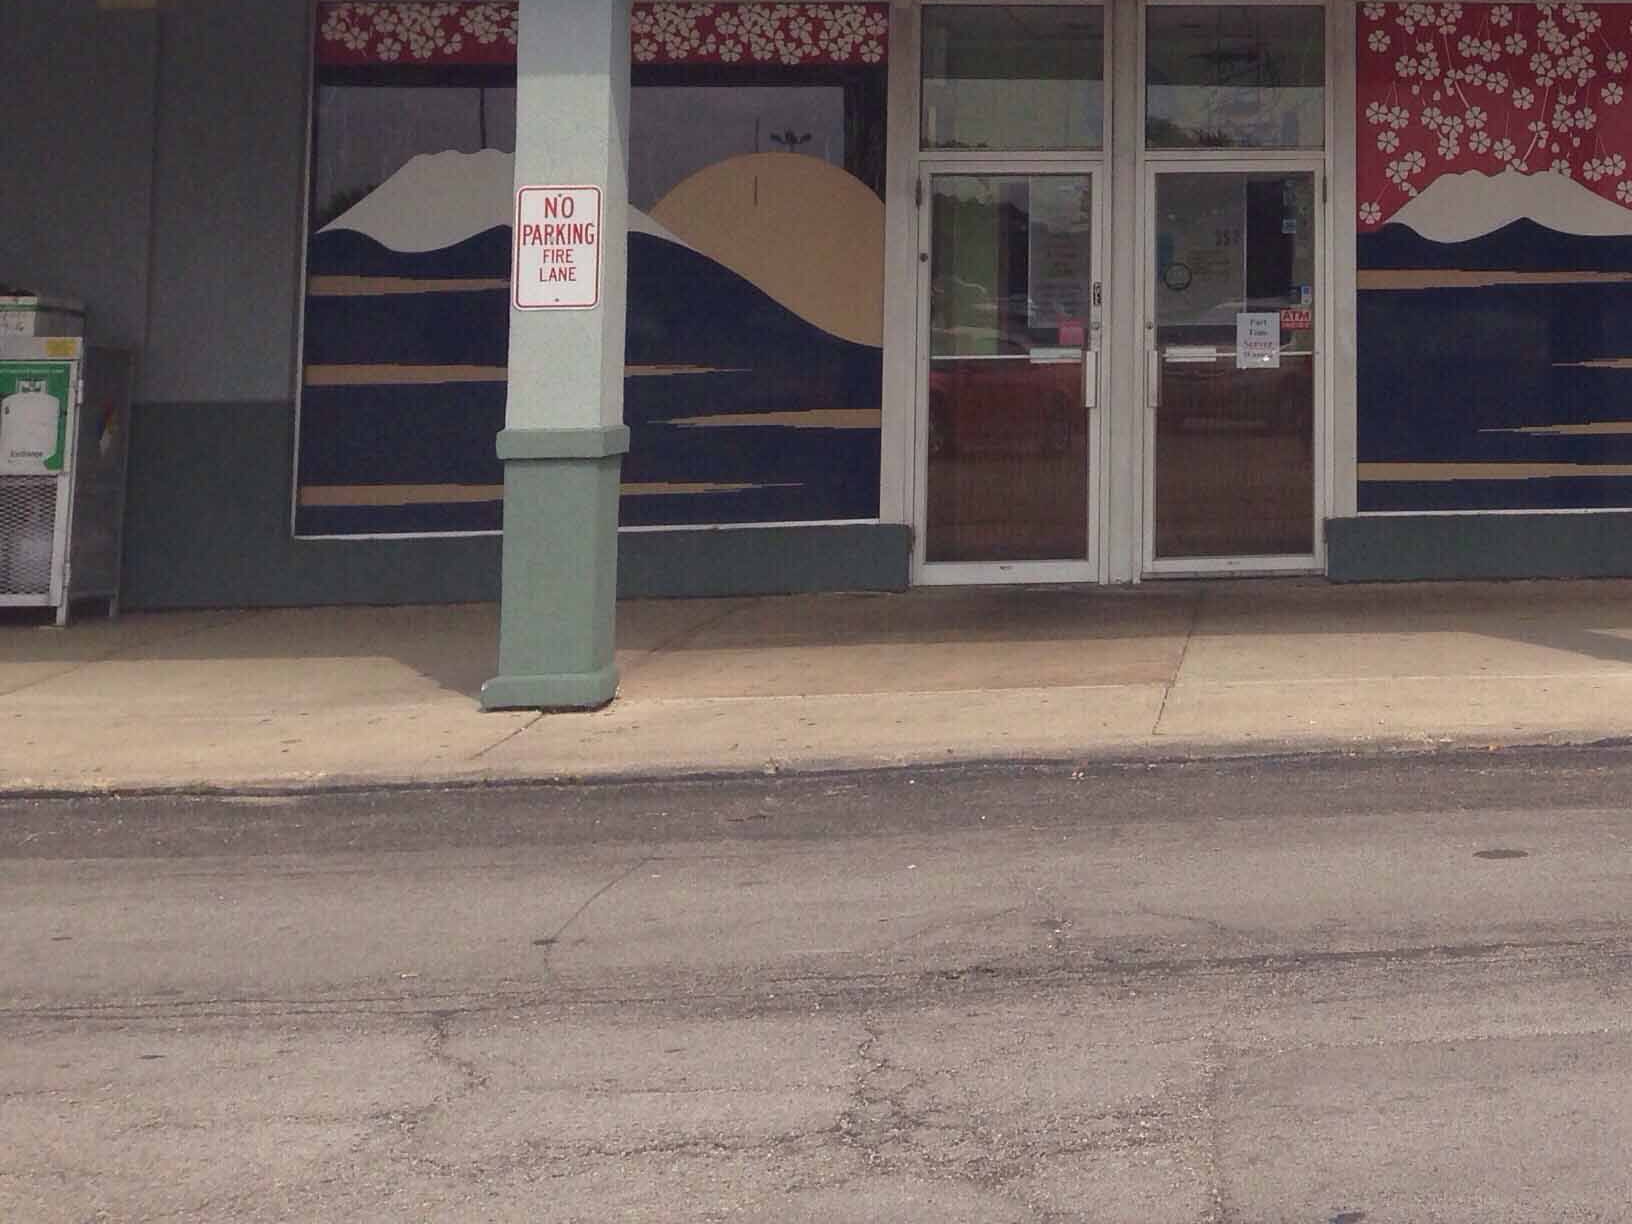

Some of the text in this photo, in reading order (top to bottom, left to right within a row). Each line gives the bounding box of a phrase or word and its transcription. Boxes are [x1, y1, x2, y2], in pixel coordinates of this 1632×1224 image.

[544, 196, 574, 218] NO
[522, 223, 595, 246] PARKING
[543, 248, 574, 264] FIRE
[539, 267, 577, 282] LANE
[1281, 309, 1312, 322] ATM
